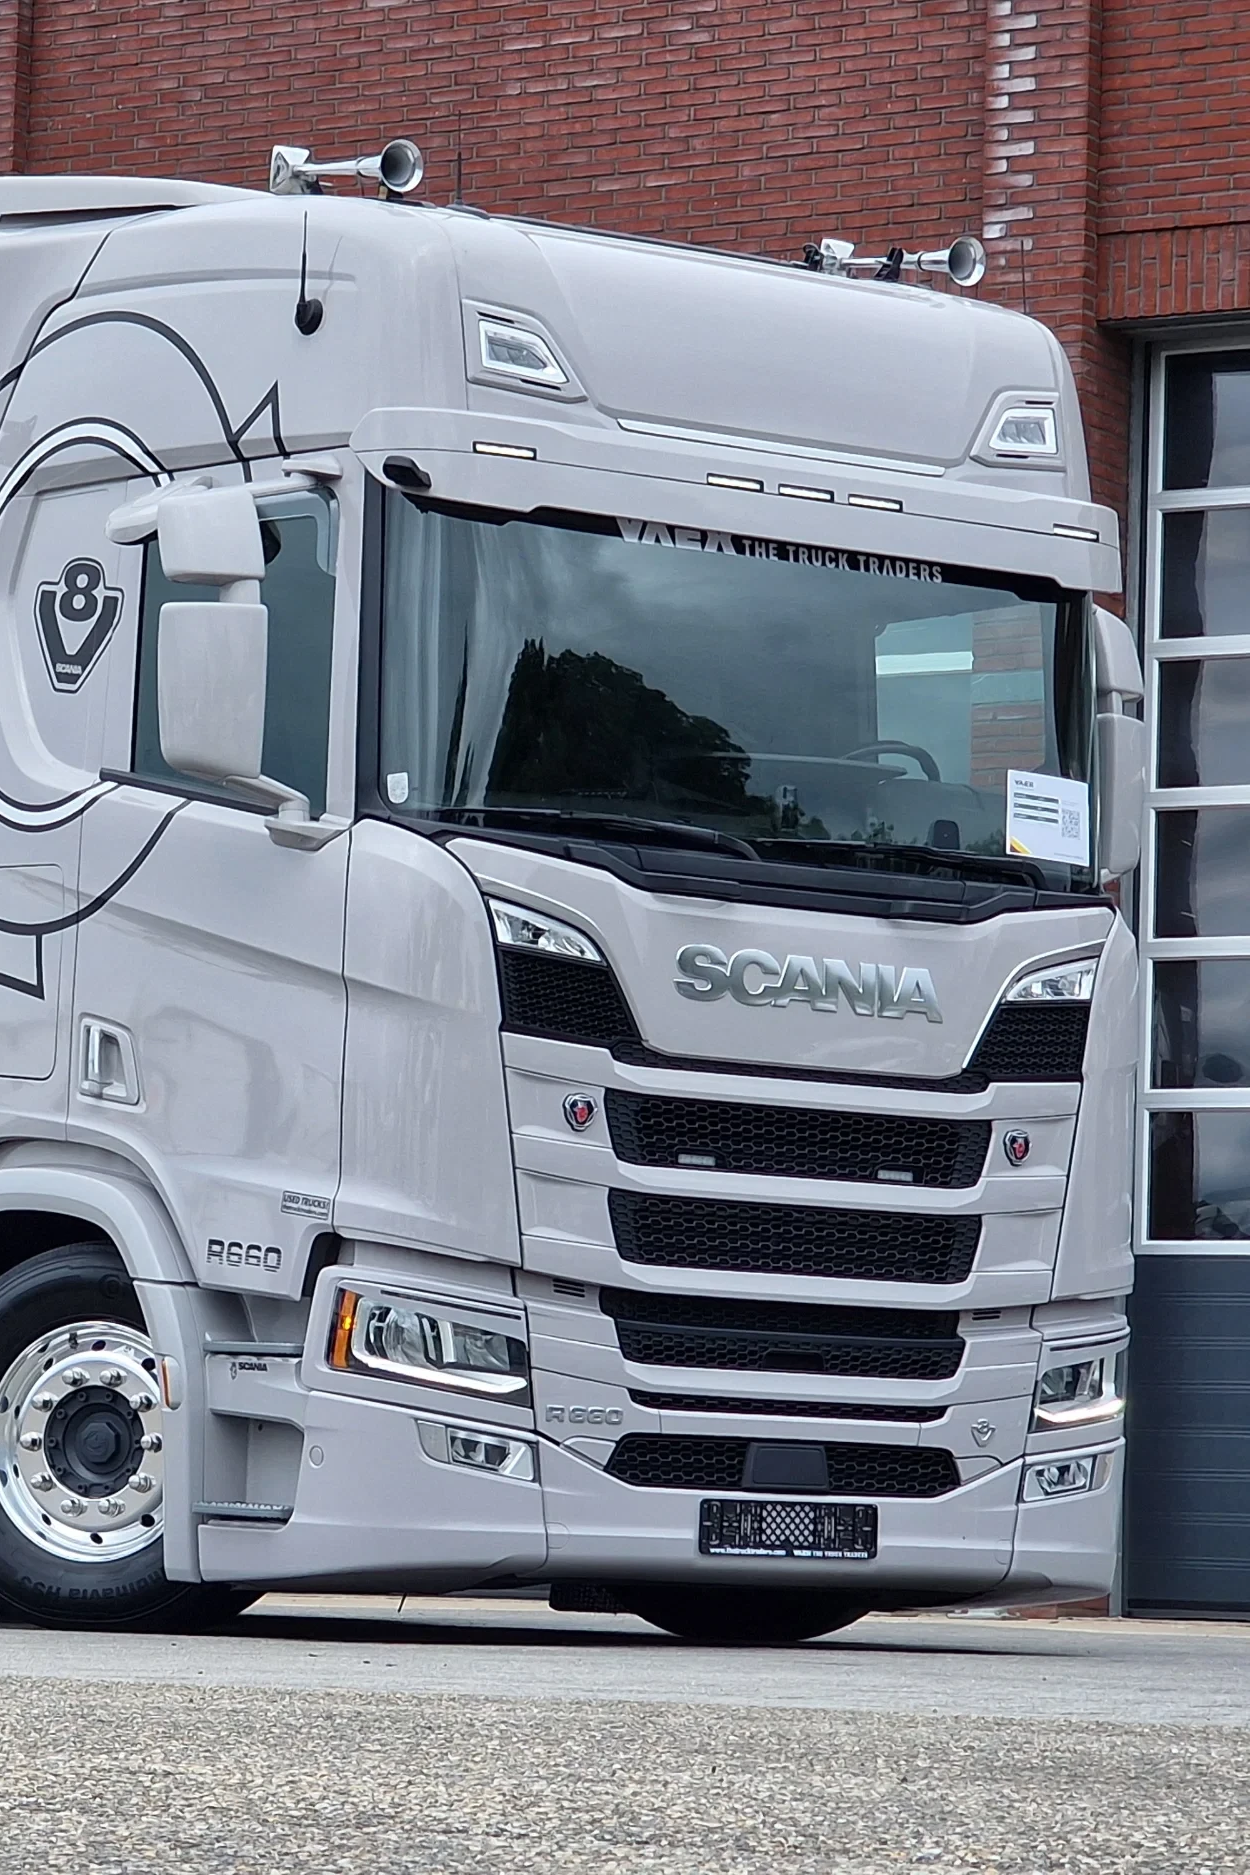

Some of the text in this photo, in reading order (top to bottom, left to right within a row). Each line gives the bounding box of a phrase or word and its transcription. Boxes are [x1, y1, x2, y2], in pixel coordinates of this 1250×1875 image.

[741, 539, 779, 561] THE
[786, 545, 850, 571] TRUCK
[857, 555, 942, 584] TRADERS
[55, 662, 83, 676] SCANIA
[673, 943, 943, 1023] SCANIA
[206, 1239, 282, 1273] R660
[238, 1361, 268, 1372] SCANIA
